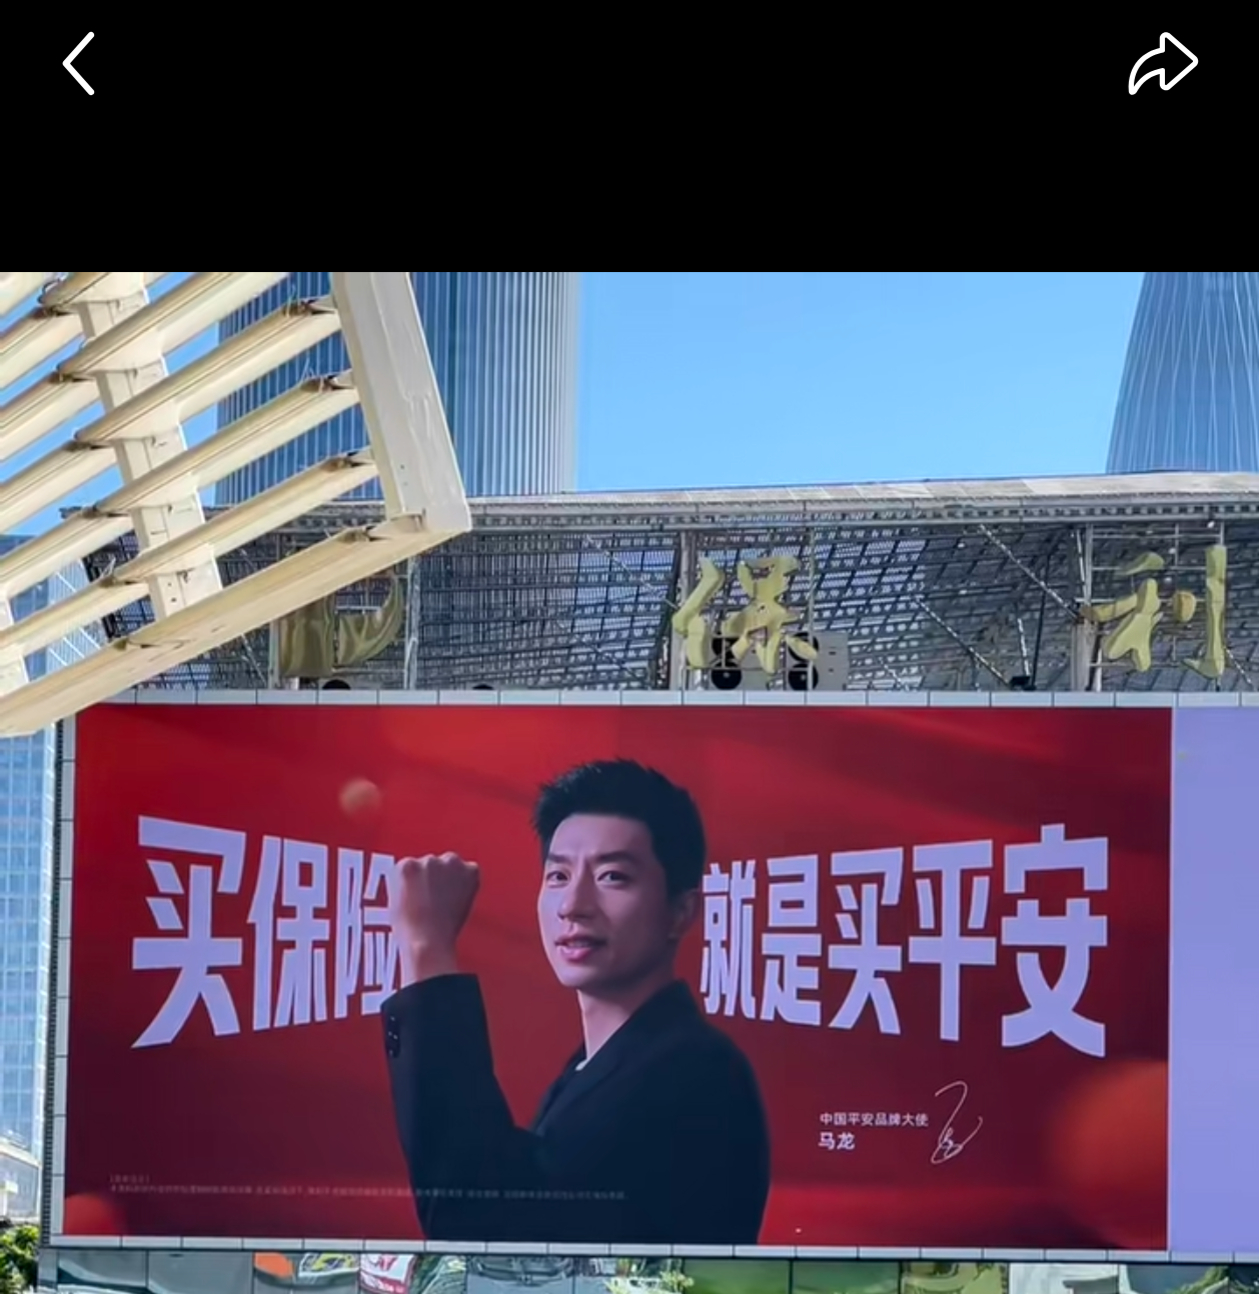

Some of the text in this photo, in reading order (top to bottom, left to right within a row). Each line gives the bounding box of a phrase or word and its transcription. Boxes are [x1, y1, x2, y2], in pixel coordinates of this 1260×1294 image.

[131, 814, 402, 1049] 买保险
[700, 823, 1109, 1058] 就是买平安
[818, 1131, 856, 1150] 马龙
[819, 1111, 929, 1127] 中国平安品牌大使
